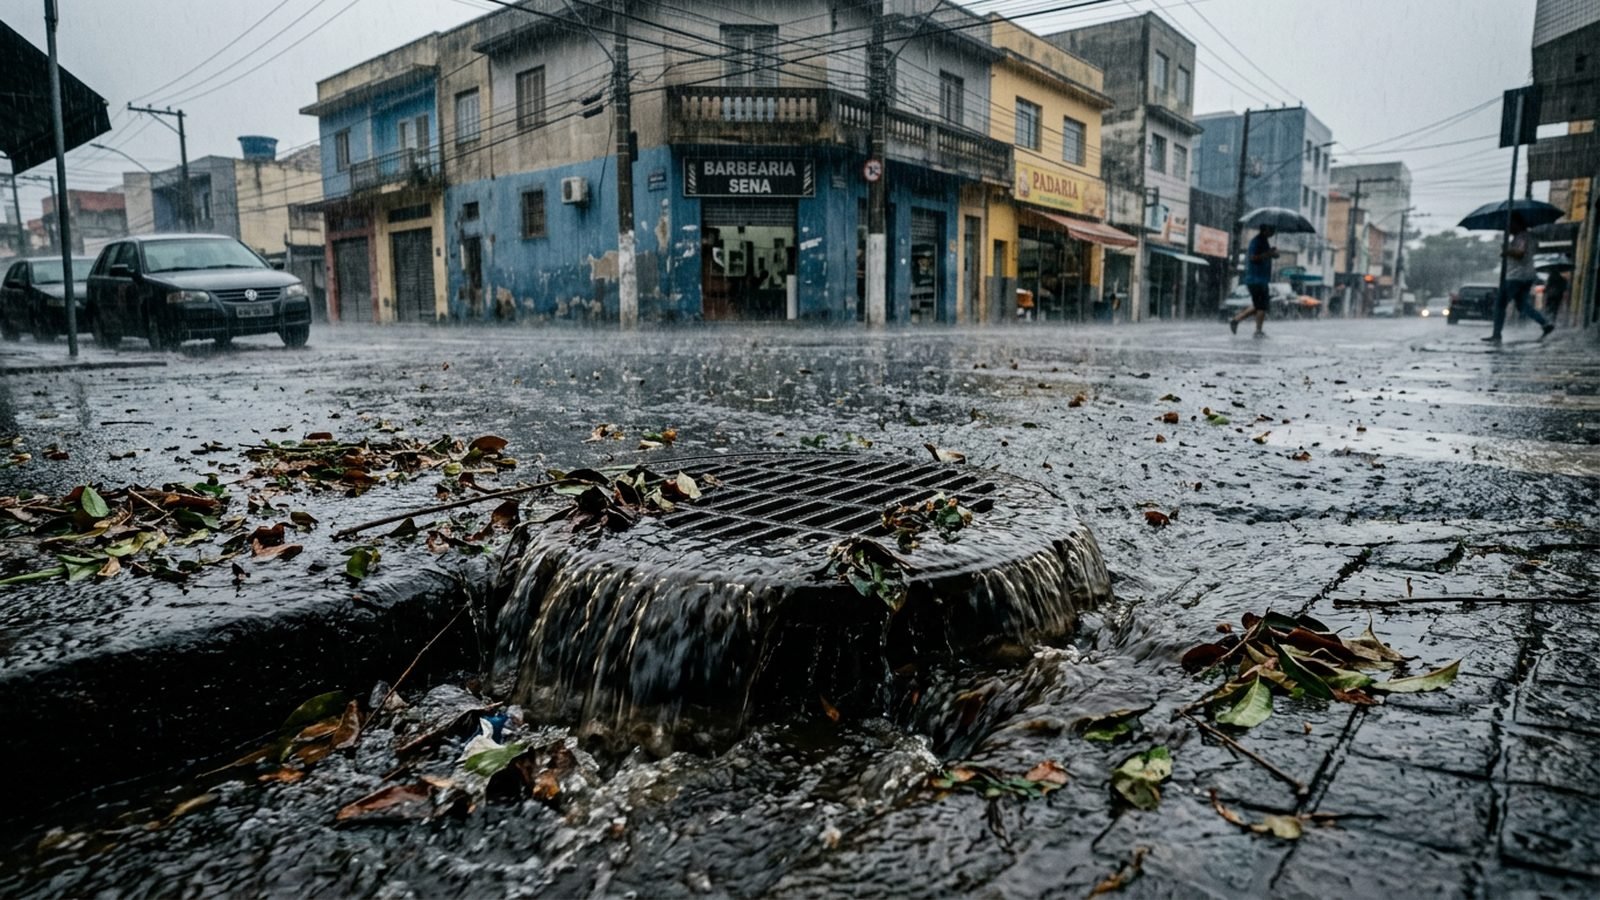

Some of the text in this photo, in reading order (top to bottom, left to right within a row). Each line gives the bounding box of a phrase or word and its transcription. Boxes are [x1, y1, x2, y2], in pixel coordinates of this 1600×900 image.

[704, 161, 796, 176] BARBEARIA
[729, 179, 772, 193] SENA
[1033, 171, 1079, 200] PADARIA
